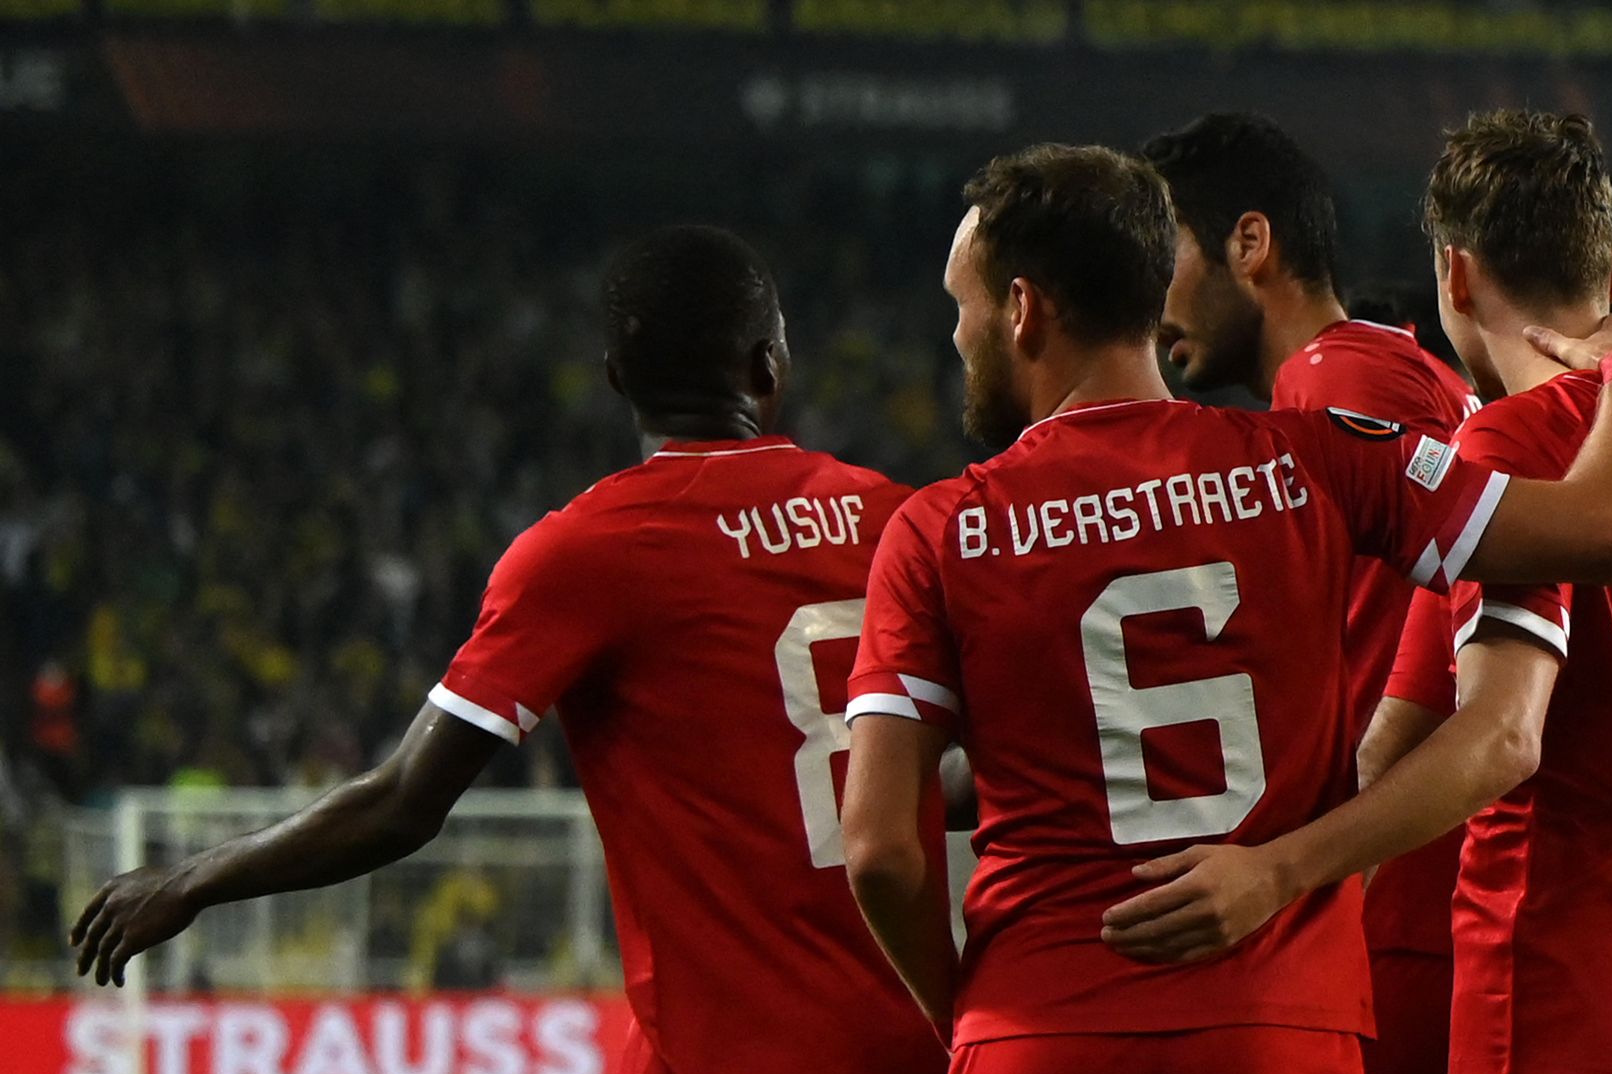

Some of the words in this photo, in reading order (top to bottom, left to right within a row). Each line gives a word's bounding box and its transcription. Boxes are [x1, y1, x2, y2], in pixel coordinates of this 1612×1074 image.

[716, 494, 865, 559] YUSUF
[957, 505, 1001, 560] B.
[1008, 452, 1308, 557] VERSTRAETE
[1080, 561, 1267, 845] 6
